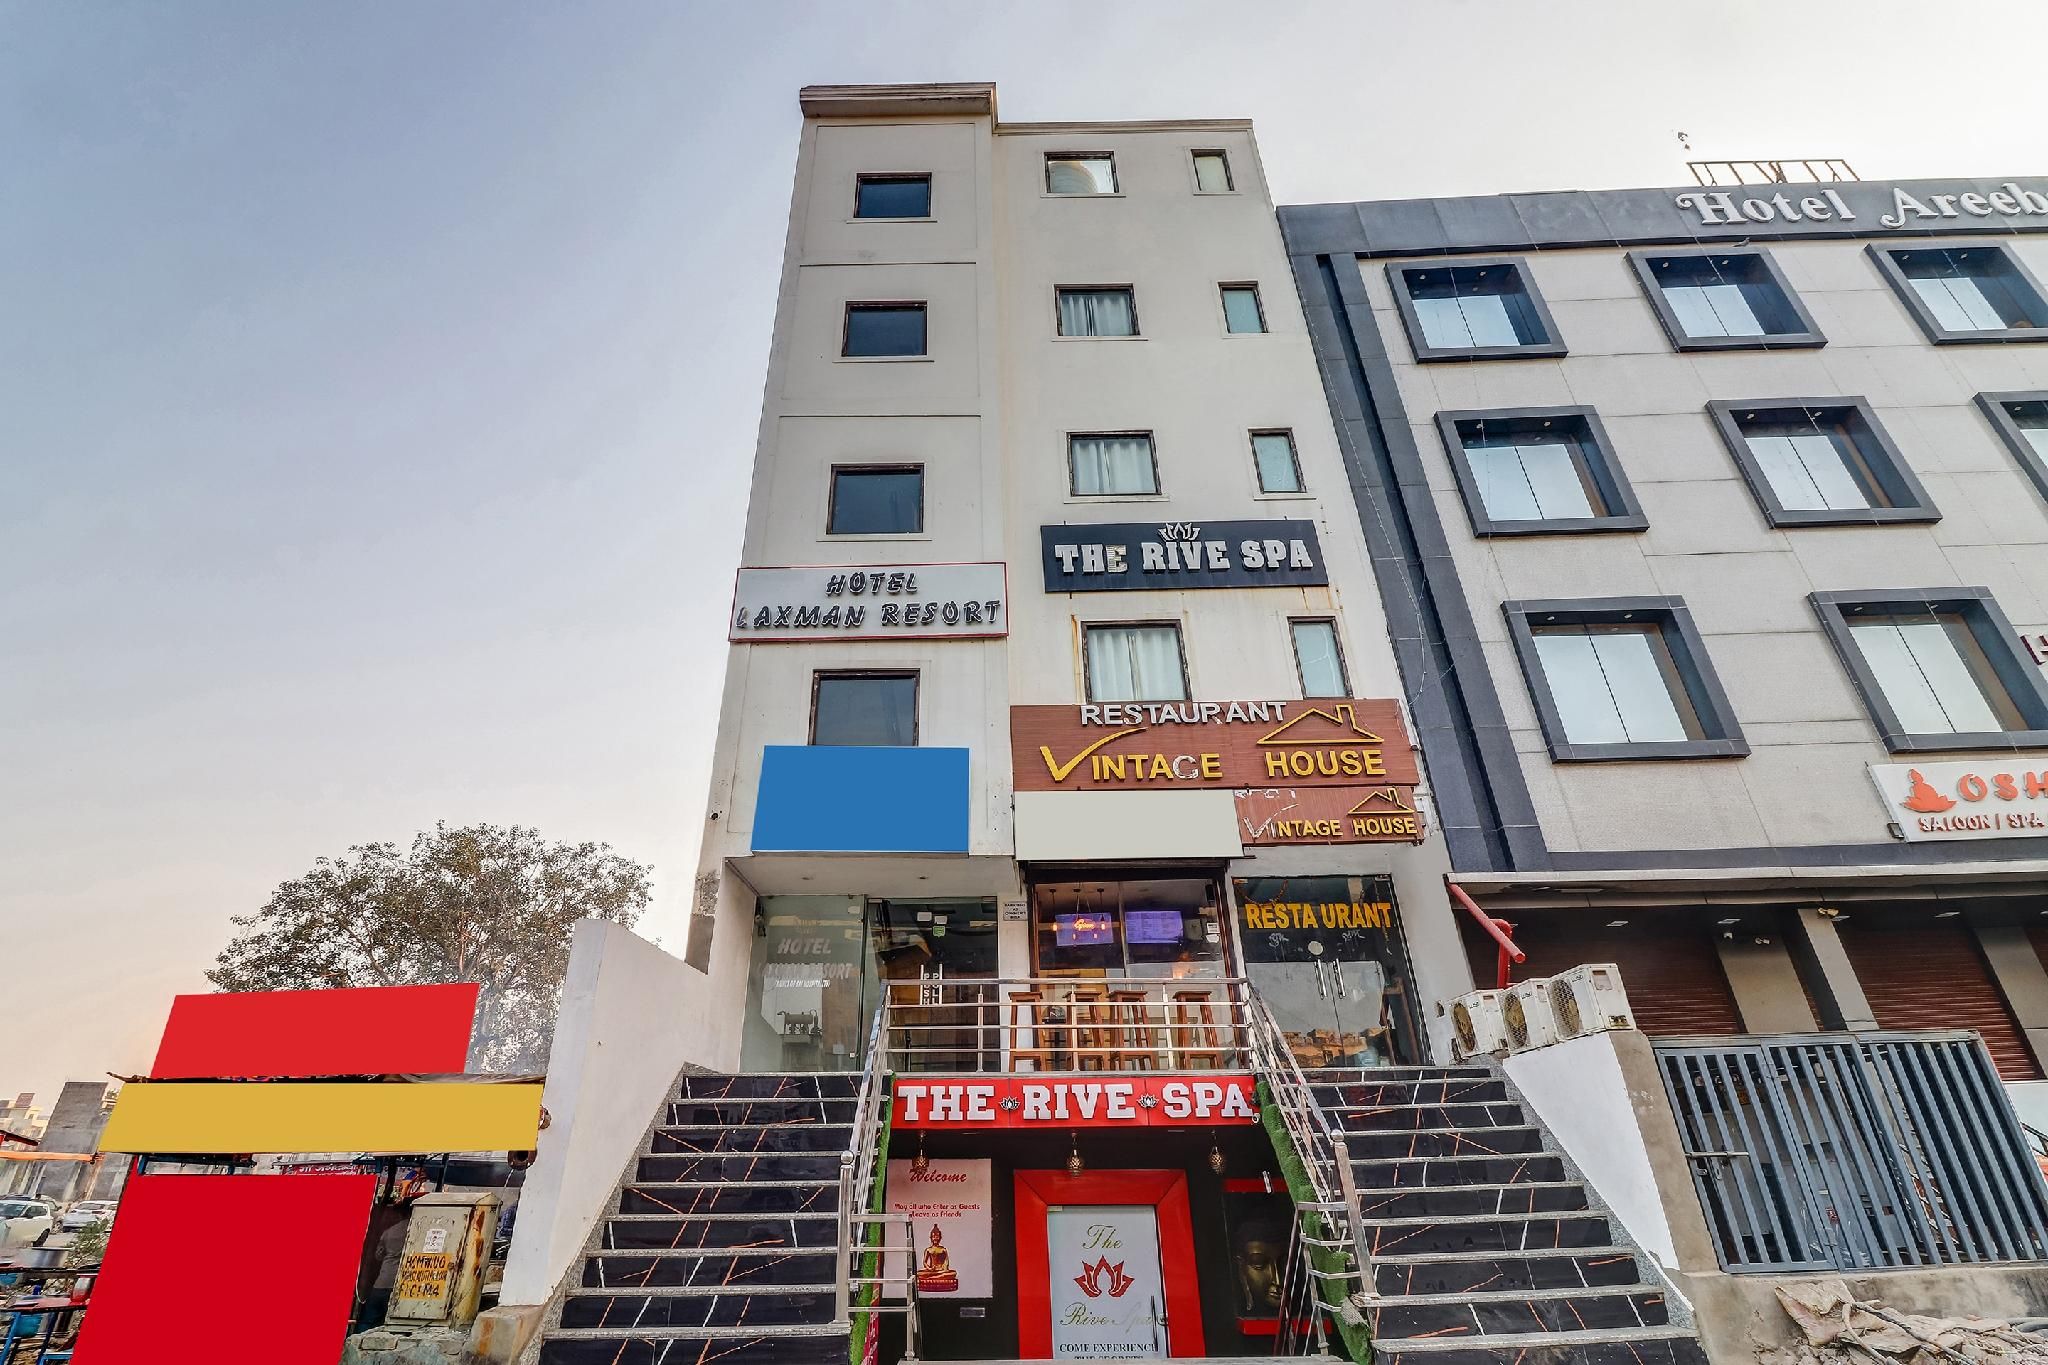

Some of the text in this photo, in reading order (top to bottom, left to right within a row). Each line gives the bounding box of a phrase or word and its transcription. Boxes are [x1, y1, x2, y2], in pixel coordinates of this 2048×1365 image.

[1676, 183, 2048, 229] Hotel Areeb
[1054, 539, 1314, 574] THE RIVE SPA
[825, 571, 918, 596] HOTEL
[736, 600, 1000, 628] LAXMAN RESORT
[1080, 701, 1288, 726] RESTAURANT
[1039, 726, 1387, 783] VINTAGE HOUSE
[1243, 803, 1418, 838] VINTAGE HOUSE
[1917, 812, 2045, 833] SALOON SPA
[777, 938, 832, 954] HOTEL
[898, 1082, 1254, 1121] THE RIVE SPA
[909, 1168, 967, 1182] Welcome
[1082, 1224, 1123, 1249] The
[1060, 1301, 1110, 1326] Rive
[1060, 1343, 1092, 1353] COME
